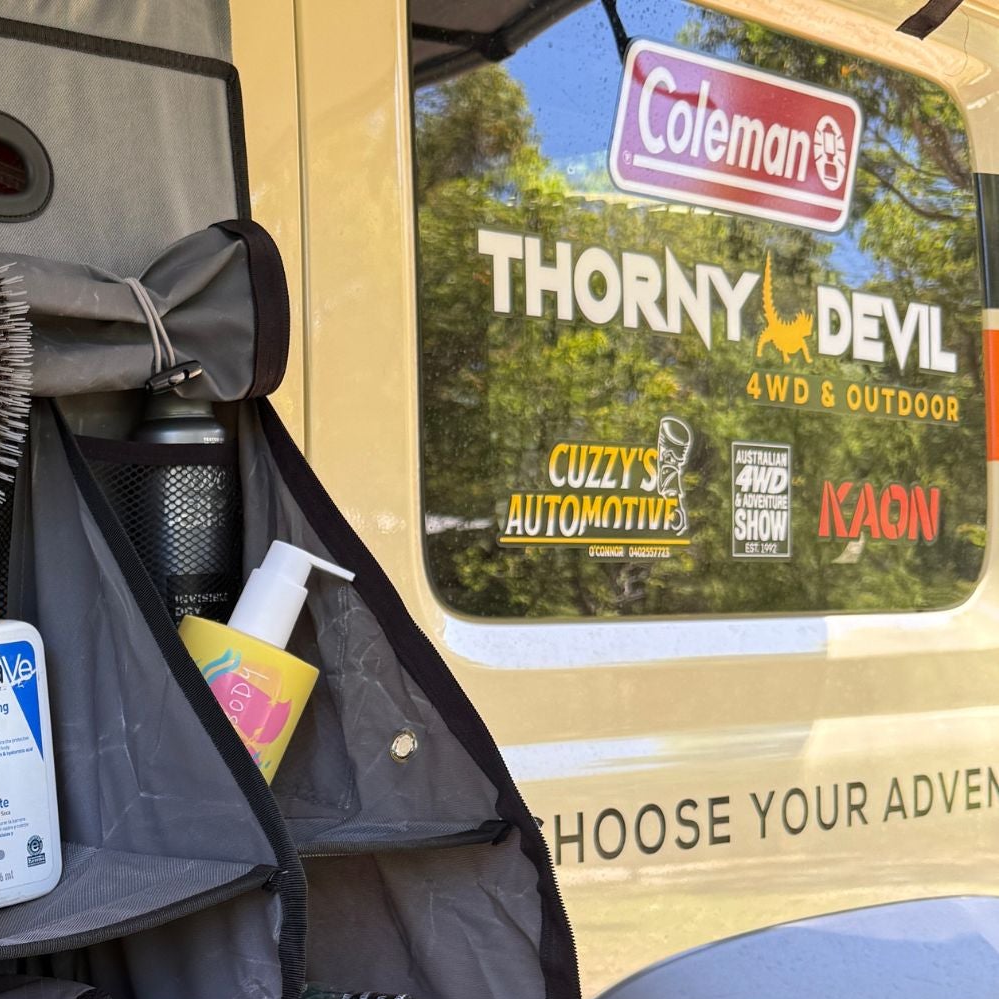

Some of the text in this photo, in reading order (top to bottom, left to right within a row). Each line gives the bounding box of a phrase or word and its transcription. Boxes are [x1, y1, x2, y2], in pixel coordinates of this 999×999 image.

[638, 66, 812, 182] Coleman
[478, 229, 958, 373] THORNY DEVIL
[747, 372, 959, 423] 4WD & OUTDOOR
[549, 443, 659, 491] CUZZY'S
[735, 450, 787, 466] AUSTRALIAN
[735, 465, 788, 494] 4WD
[735, 493, 788, 509] & ADVENTURE
[818, 480, 940, 541] KAON
[734, 508, 788, 541] SHOW
[589, 545, 624, 557] O'CONNOR
[761, 543, 778, 554] 1992
[534, 796, 731, 866] HOOSE
[749, 781, 869, 839] YOUR
